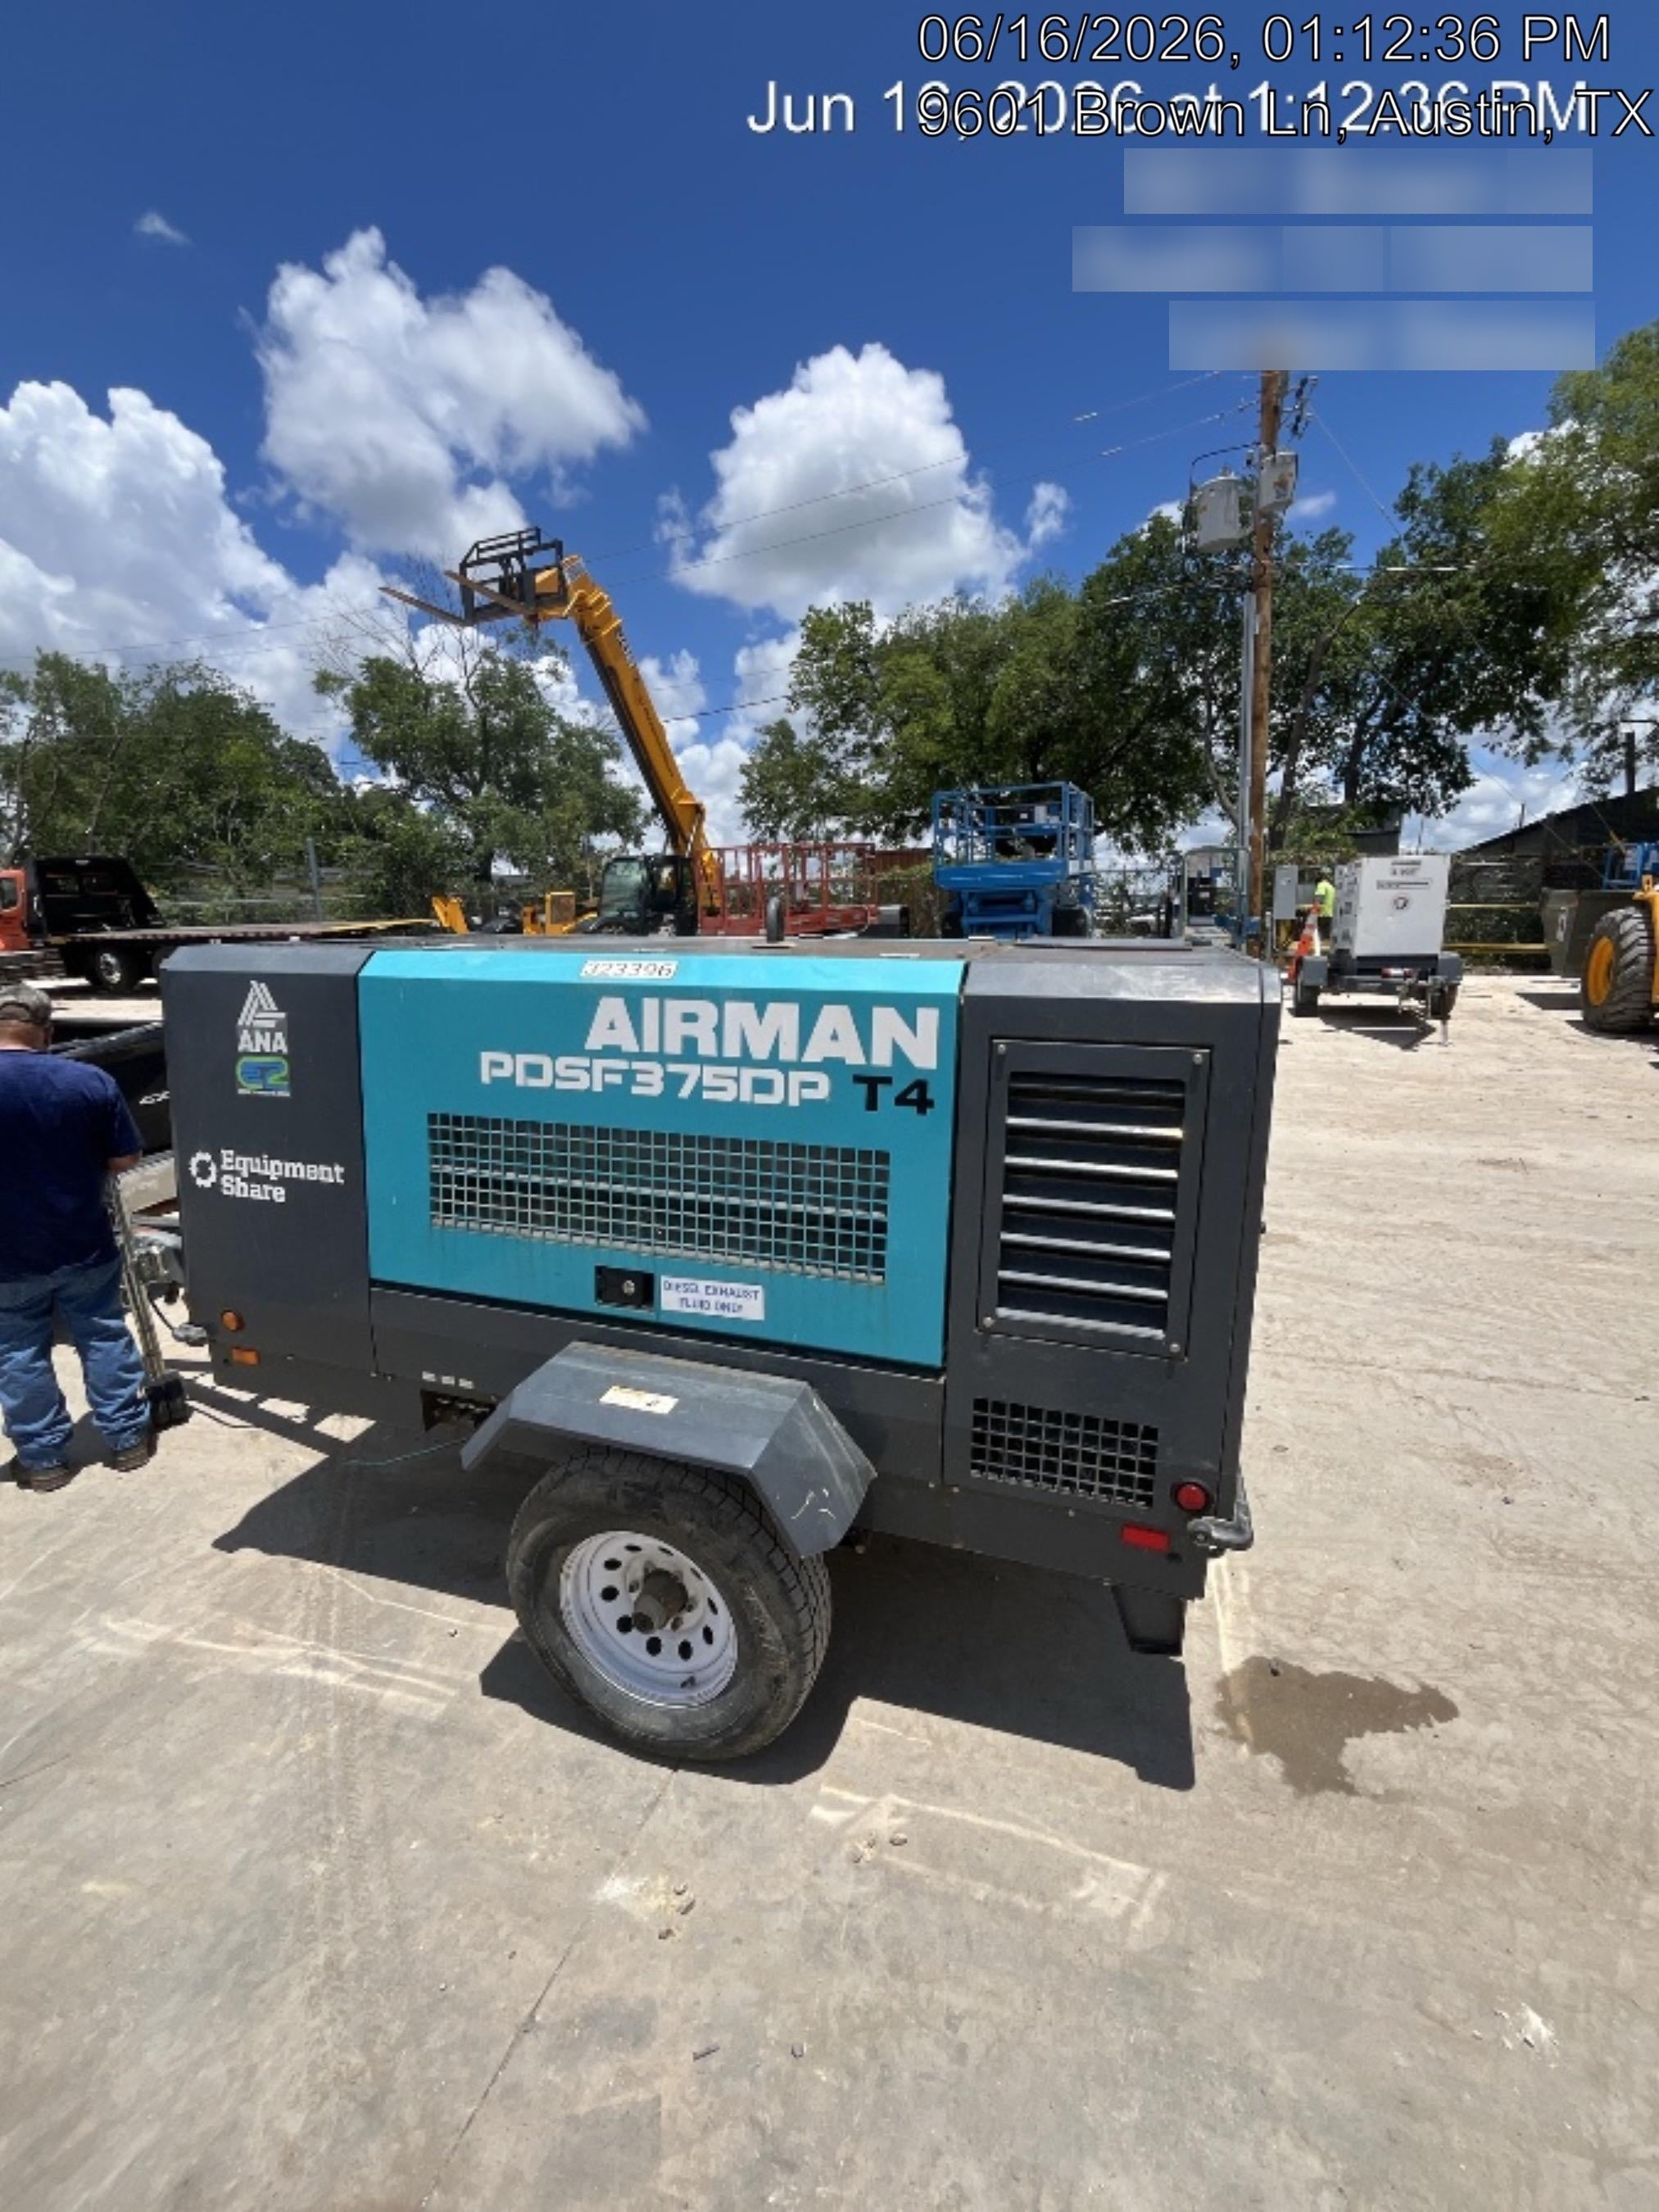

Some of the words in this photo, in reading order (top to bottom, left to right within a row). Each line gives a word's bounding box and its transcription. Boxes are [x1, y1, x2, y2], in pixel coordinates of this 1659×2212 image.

[238, 1030, 288, 1054] ANA
[584, 996, 939, 1070] AIRMAN
[479, 1051, 831, 1107] PDSF375DP
[852, 1074, 935, 1116] T4
[220, 1149, 345, 1185] Equipment
[220, 1175, 286, 1203] Share
[664, 1281, 699, 1294] DIESEL
[705, 1285, 759, 1300] EXHAUST
